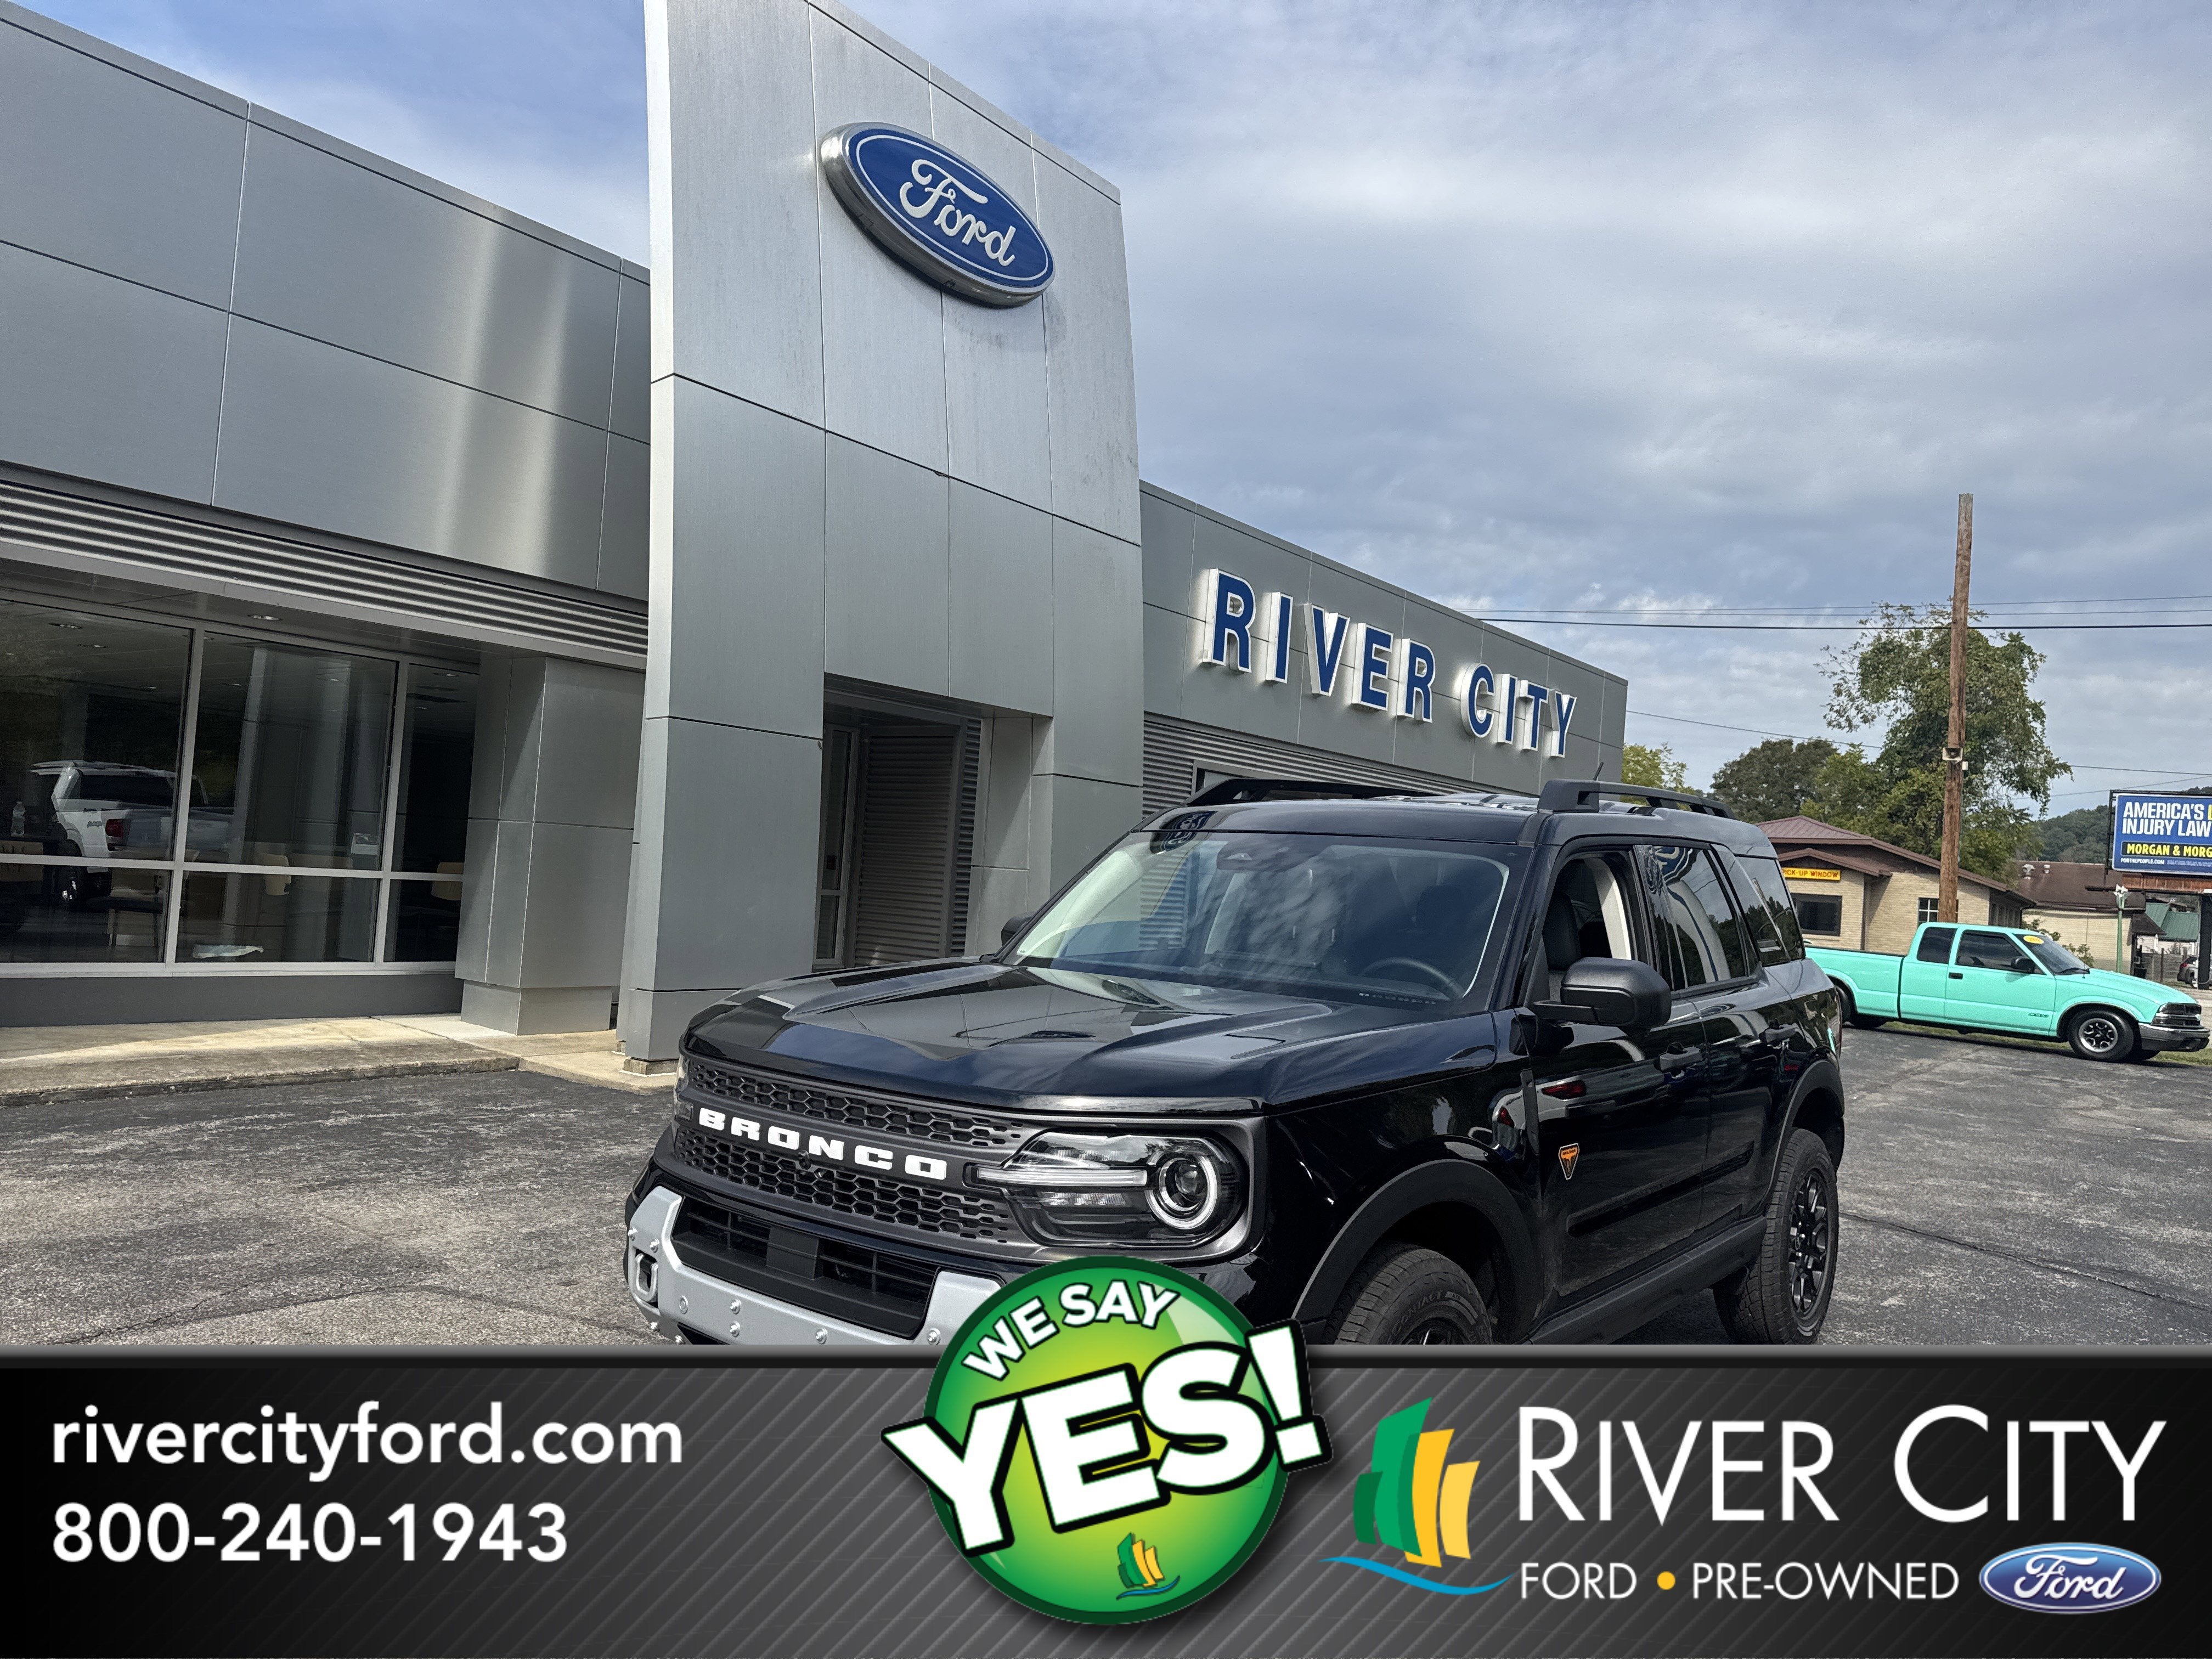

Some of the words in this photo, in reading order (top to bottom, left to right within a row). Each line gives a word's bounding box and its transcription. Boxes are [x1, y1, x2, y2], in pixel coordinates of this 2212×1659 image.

[900, 159, 1017, 266] Ford
[1203, 568, 1435, 723] RIVER
[1460, 663, 1577, 758] CITY
[2123, 802, 2204, 820] AMERICA'S
[2122, 818, 2175, 836] INJURY
[2177, 820, 2211, 837] LAW
[2126, 843, 2170, 856] MORGAN
[2172, 845, 2180, 856] &
[1810, 870, 1838, 878] WINDOW
[699, 1108, 947, 1180] BRONCO
